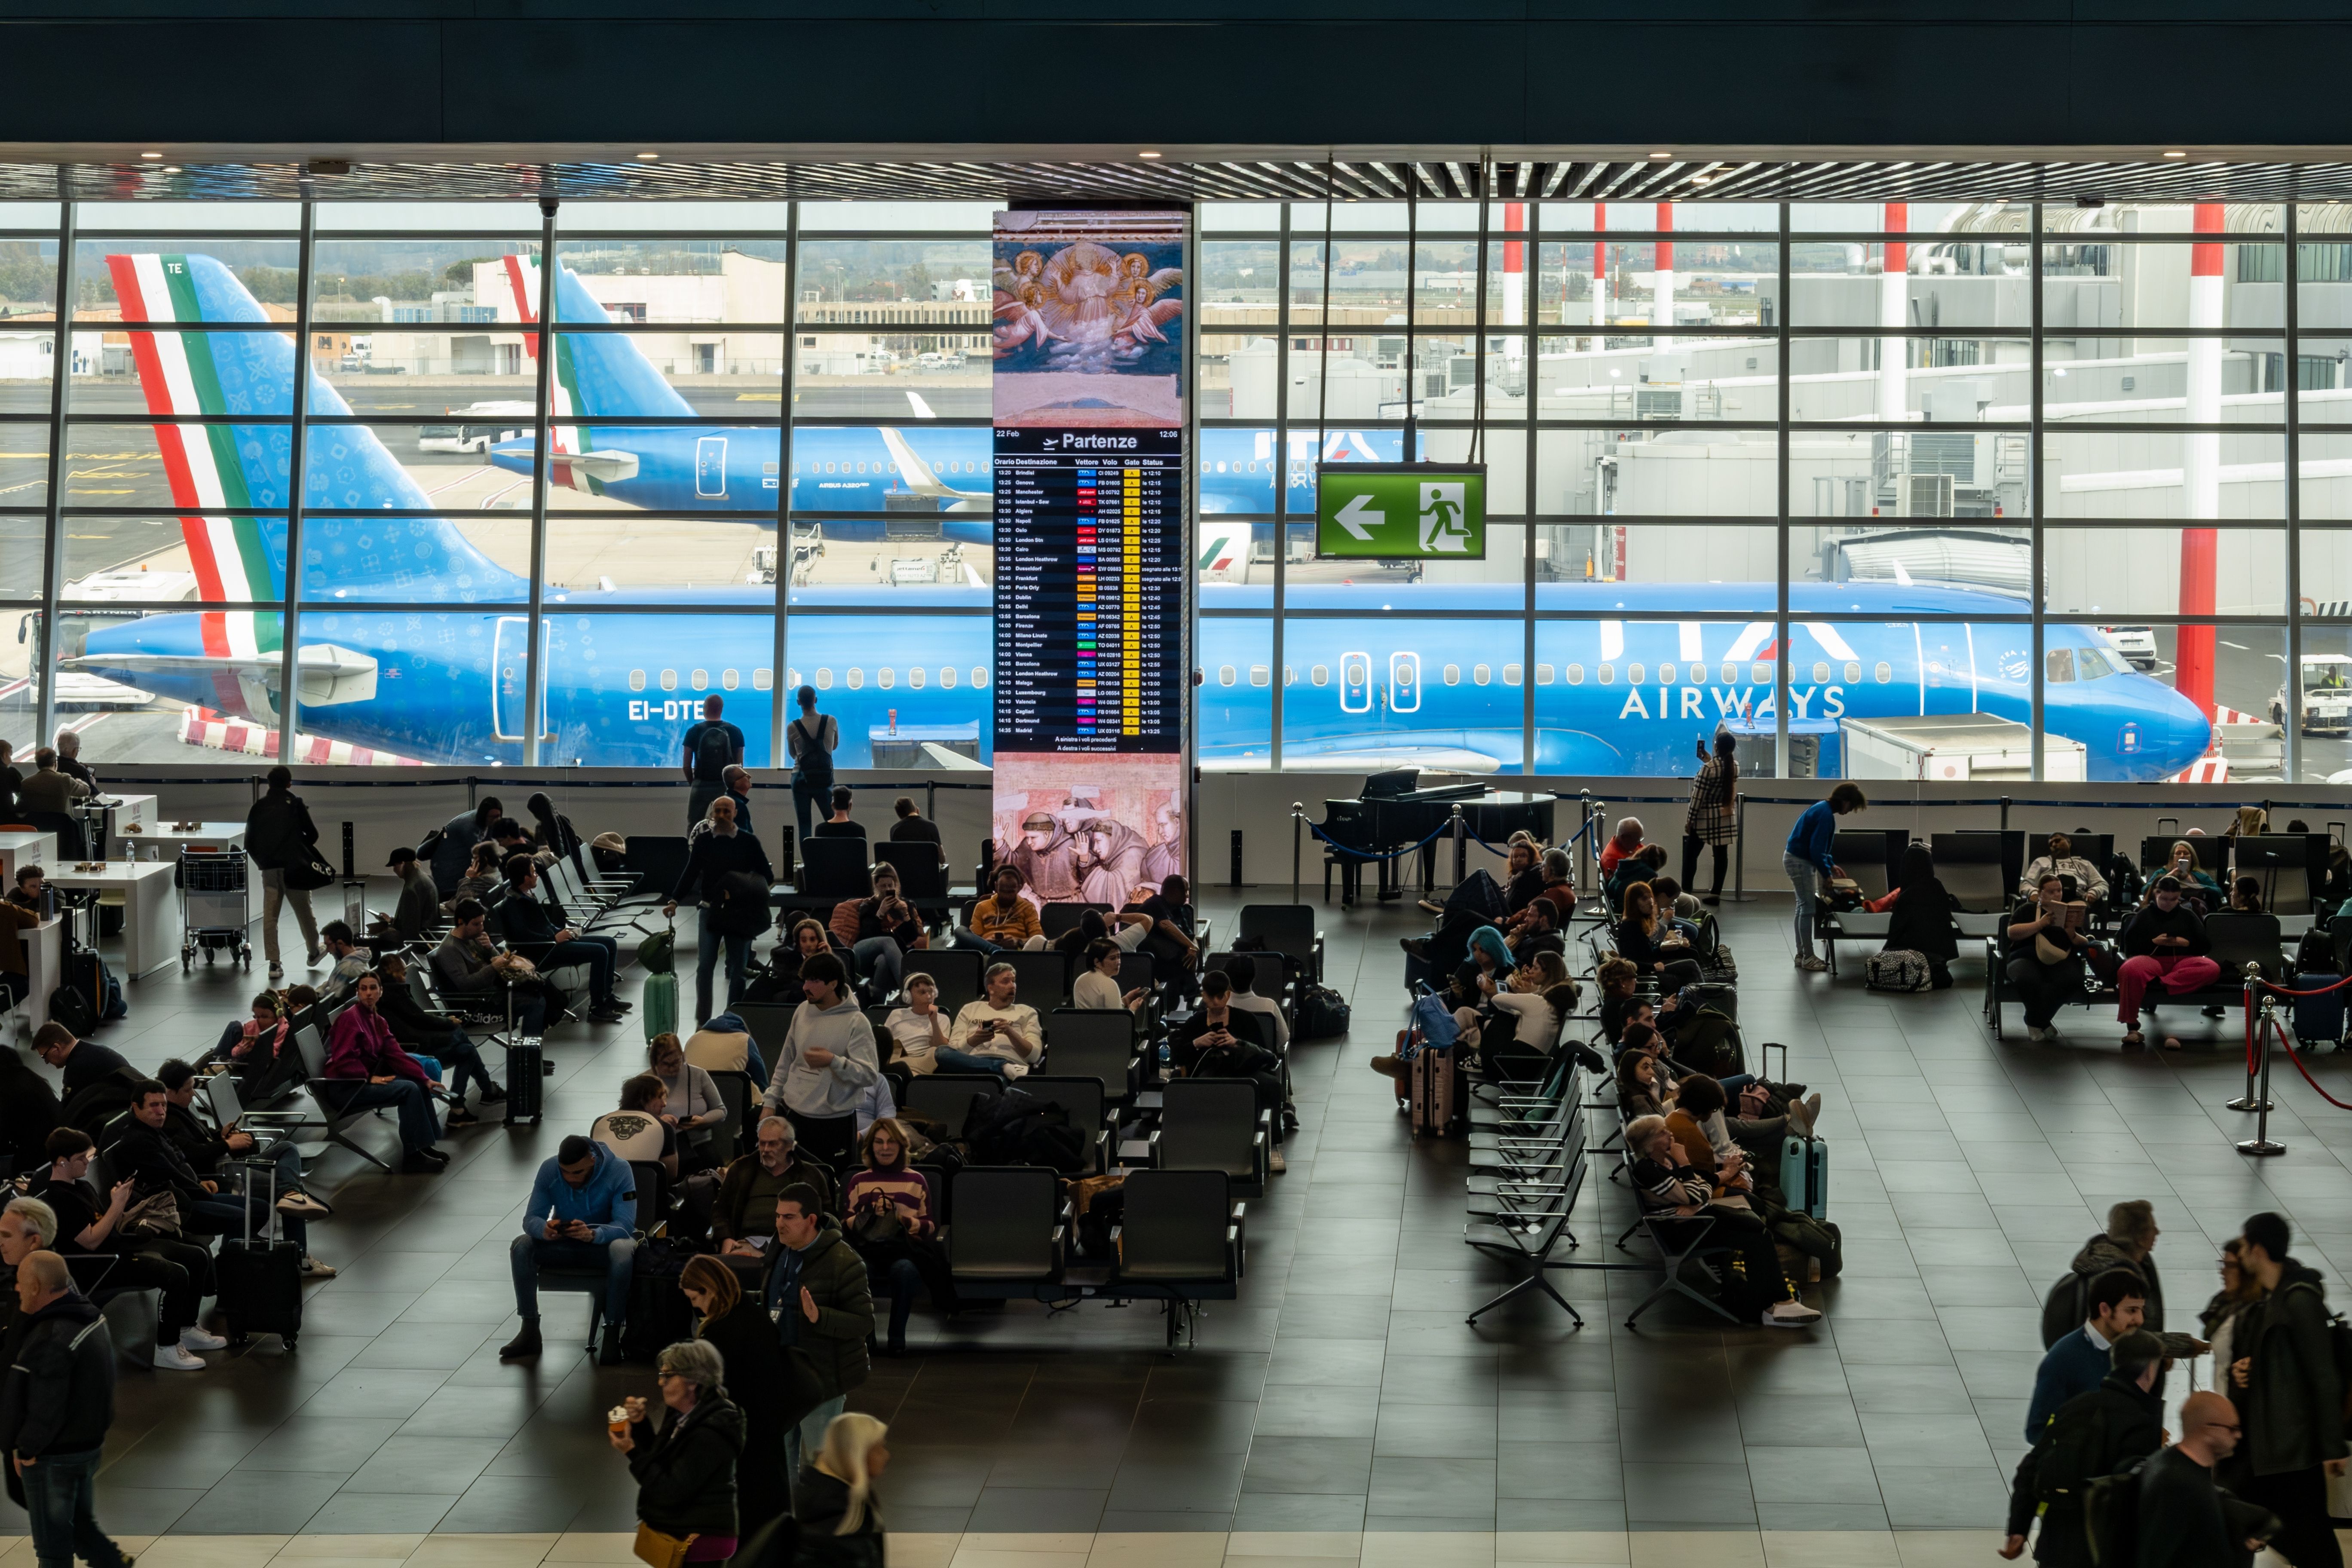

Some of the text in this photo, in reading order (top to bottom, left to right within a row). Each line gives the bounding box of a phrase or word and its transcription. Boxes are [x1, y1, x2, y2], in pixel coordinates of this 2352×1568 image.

[167, 263, 182, 274] TE
[1063, 434, 1137, 448] Partenze
[629, 701, 705, 720] EI-DTE
[1619, 686, 1845, 719] AIRWAYS
